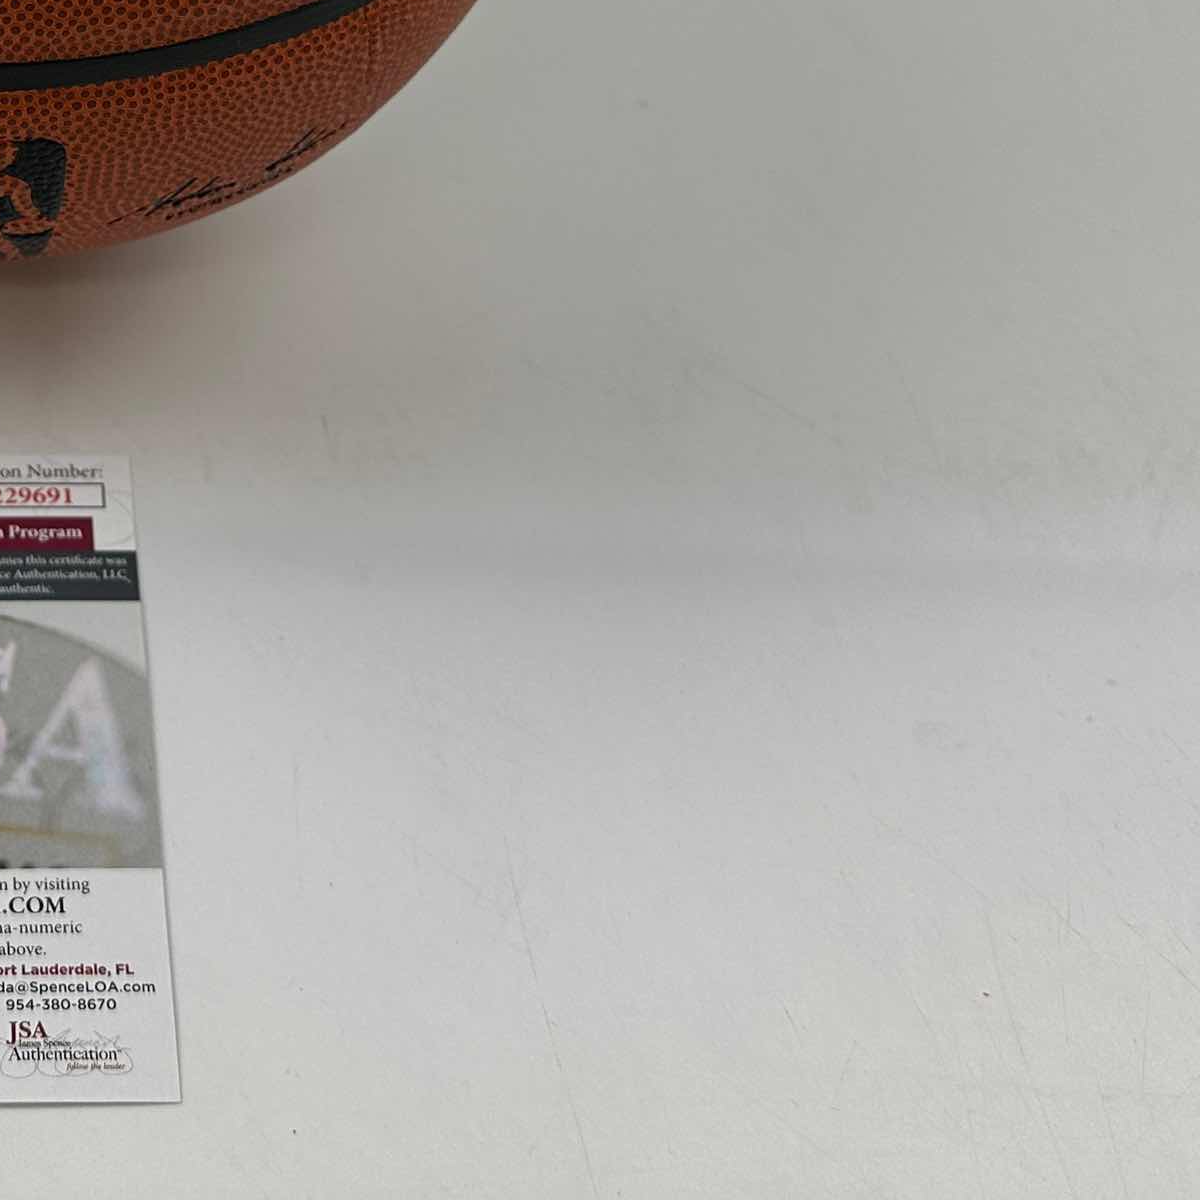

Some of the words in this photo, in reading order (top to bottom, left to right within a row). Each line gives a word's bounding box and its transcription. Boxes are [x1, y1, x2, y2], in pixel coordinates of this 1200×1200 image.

[27, 463, 104, 480] Number:
[8, 524, 83, 541] Program
[25, 555, 47, 565] this
[49, 555, 103, 566] certificate
[13, 877, 31, 894] by
[35, 876, 90, 893] visiting
[22, 963, 111, 978] Lauderdale,
[115, 964, 135, 975] FL
[6, 999, 117, 1011] 954-380-8670
[6, 1020, 47, 1045] JSA
